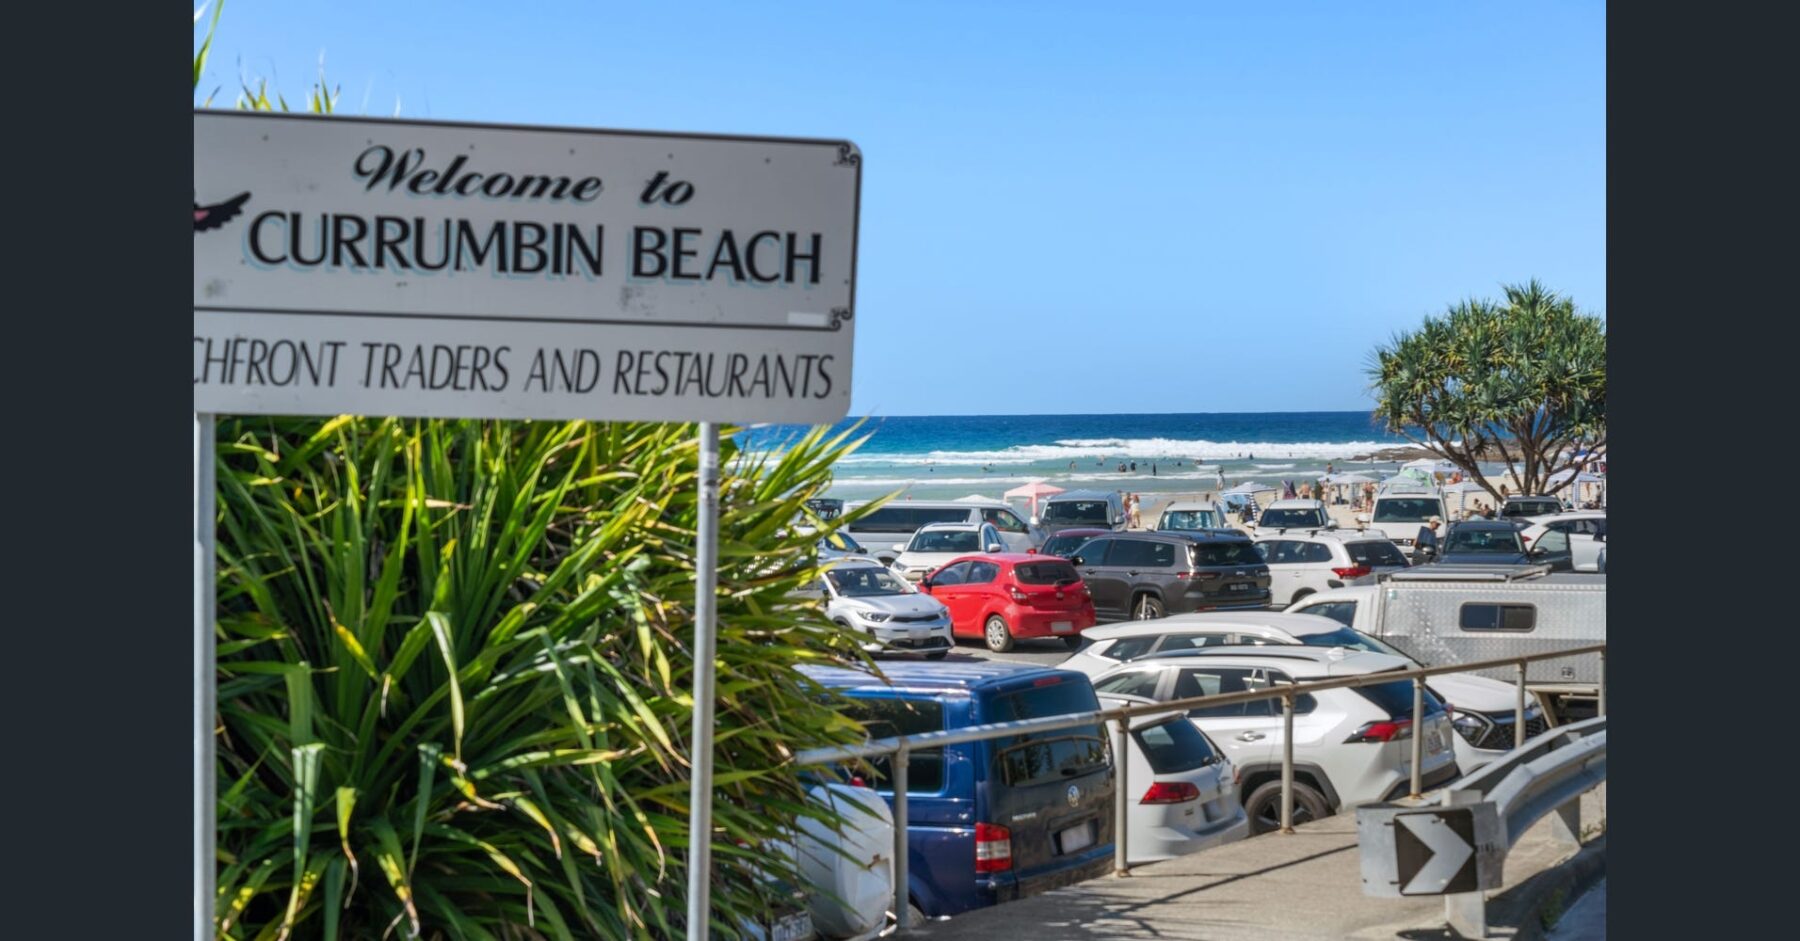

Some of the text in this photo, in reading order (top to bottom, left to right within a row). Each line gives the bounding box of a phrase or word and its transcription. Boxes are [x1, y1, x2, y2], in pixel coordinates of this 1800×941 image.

[353, 145, 696, 206] Welcome to
[249, 210, 823, 284] CURRUMBIN BEACH
[361, 342, 511, 393] TRADERS
[523, 347, 600, 394] AND
[613, 350, 834, 399] RESTAURANTS
